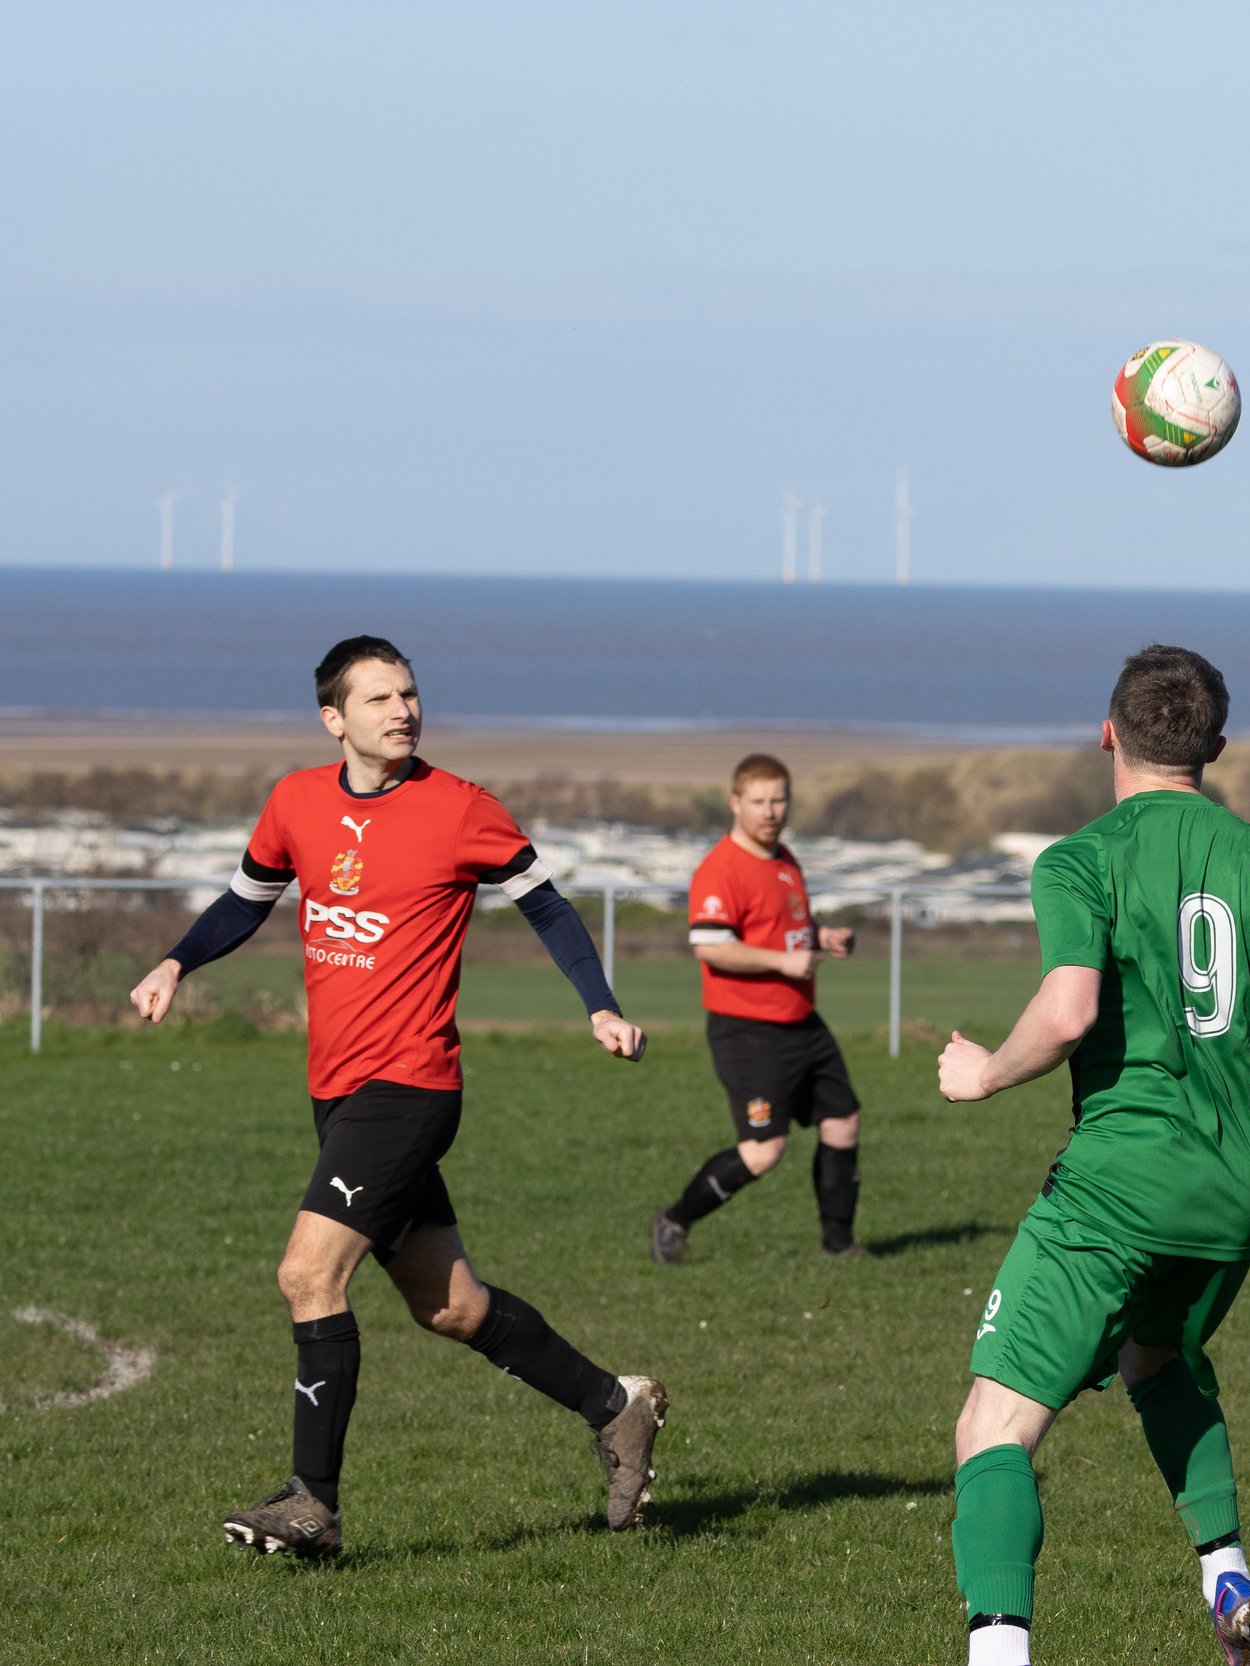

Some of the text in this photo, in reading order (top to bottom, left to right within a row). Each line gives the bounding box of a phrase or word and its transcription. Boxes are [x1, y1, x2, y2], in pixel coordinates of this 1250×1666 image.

[304, 898, 391, 944] PSS
[1176, 892, 1237, 1039] 9
[985, 1288, 1002, 1321] 9
